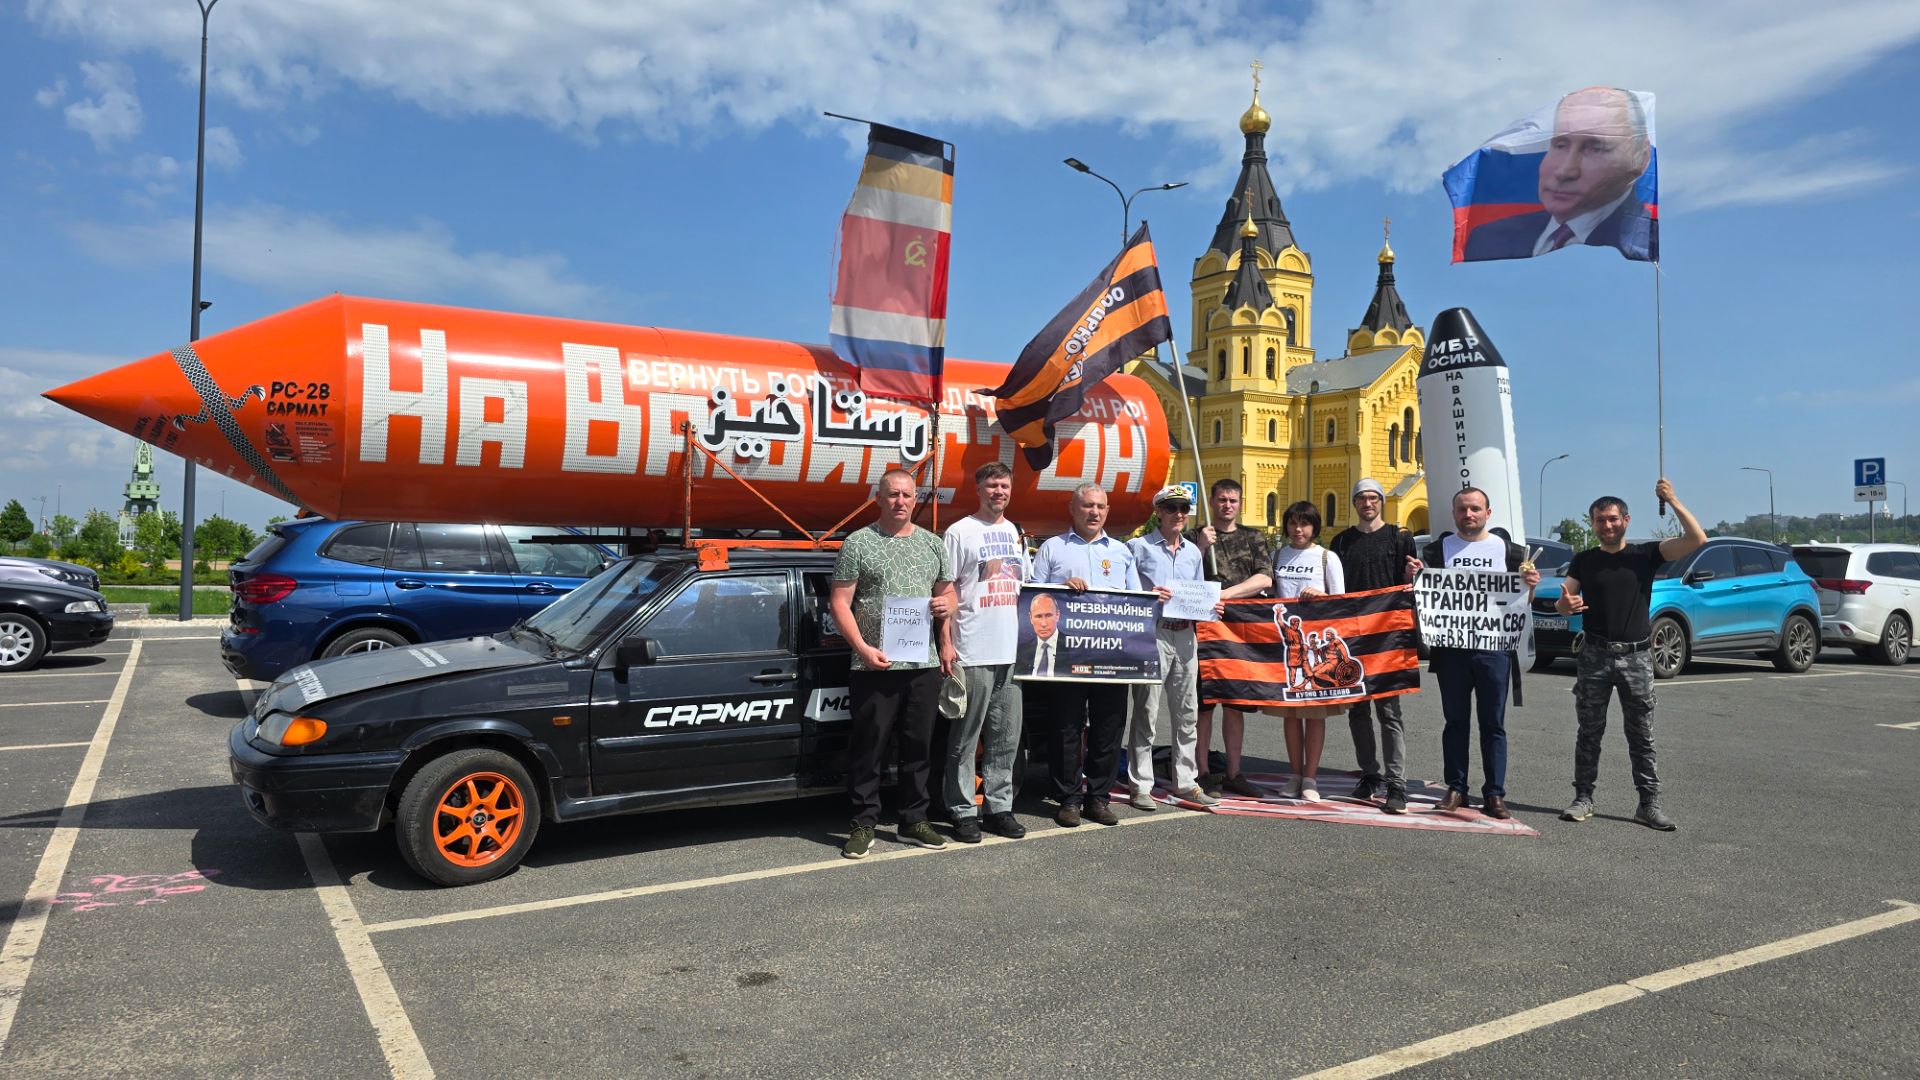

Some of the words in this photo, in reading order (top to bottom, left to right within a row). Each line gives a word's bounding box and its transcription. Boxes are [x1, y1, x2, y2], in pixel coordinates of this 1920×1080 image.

[1430, 336, 1480, 357] МБР
[1428, 351, 1486, 369] ОСИНА
[1445, 371, 1464, 382] НА
[270, 381, 331, 401] РС-28
[628, 359, 761, 394] ВЕРНУТЬ
[1109, 398, 1149, 422] РФ!
[266, 401, 329, 417] САРМАТ
[1451, 385, 1471, 490] ВАШИНГТОН
[1862, 461, 1880, 483] P
[983, 531, 1015, 545] НАША
[979, 544, 1016, 559] СТРАНА
[1278, 565, 1315, 574] РВСН
[1453, 557, 1493, 567] РВСН
[1421, 572, 1521, 593] ПРАВЛЕНИЕ
[1414, 589, 1489, 613] СТРАНОЙ
[888, 607, 921, 617] ТЕПЕРЬ
[1066, 602, 1153, 618] ЧРЕЗВЫЧАЙНЫЕ
[887, 617, 924, 627] САРМАТ!
[1065, 618, 1145, 633] ПОЛНОМОЧИЯ
[1502, 612, 1527, 633] СВО
[897, 638, 924, 649] Путин
[1065, 635, 1123, 650] ПУТИНУ!
[643, 697, 794, 728] САРМАТ
